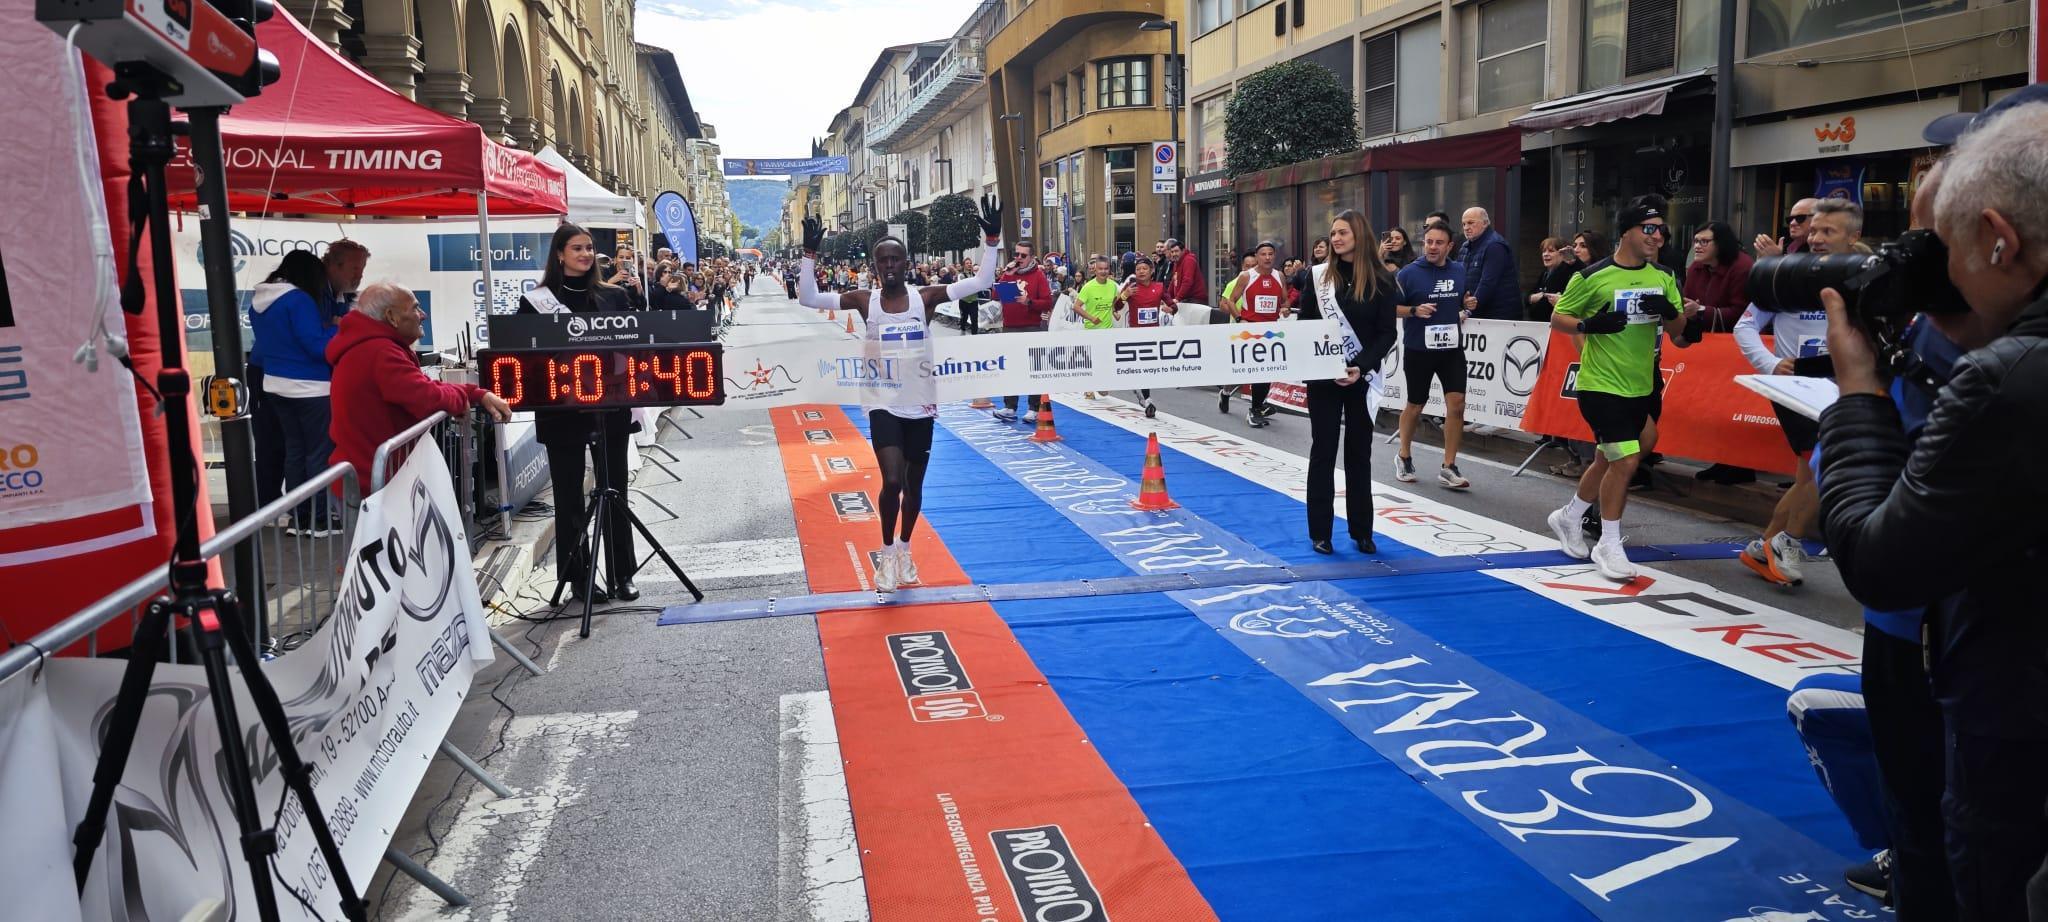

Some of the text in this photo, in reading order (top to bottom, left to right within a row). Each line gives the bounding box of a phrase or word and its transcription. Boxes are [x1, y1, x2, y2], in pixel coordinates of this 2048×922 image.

[324, 149, 443, 170] TIMING
[469, 245, 531, 261] icon.it
[614, 333, 639, 341] TIMING
[1029, 346, 1092, 371] TCA
[1115, 339, 1202, 362] SECO
[1231, 341, 1287, 364] iren
[836, 358, 893, 381] TESI
[919, 355, 1007, 378] Safimet
[1116, 367, 1142, 375] Endless
[1142, 367, 1160, 376] ways
[1169, 365, 1181, 373] the
[1181, 364, 1202, 372] future
[1266, 364, 1288, 372] servizi
[1732, 412, 1742, 421] LA
[320, 735, 338, 766] 19
[339, 695, 378, 744] 52100
[306, 847, 330, 890] 057
[329, 795, 359, 850] 50889
[353, 698, 421, 801] www.motorauto.it
